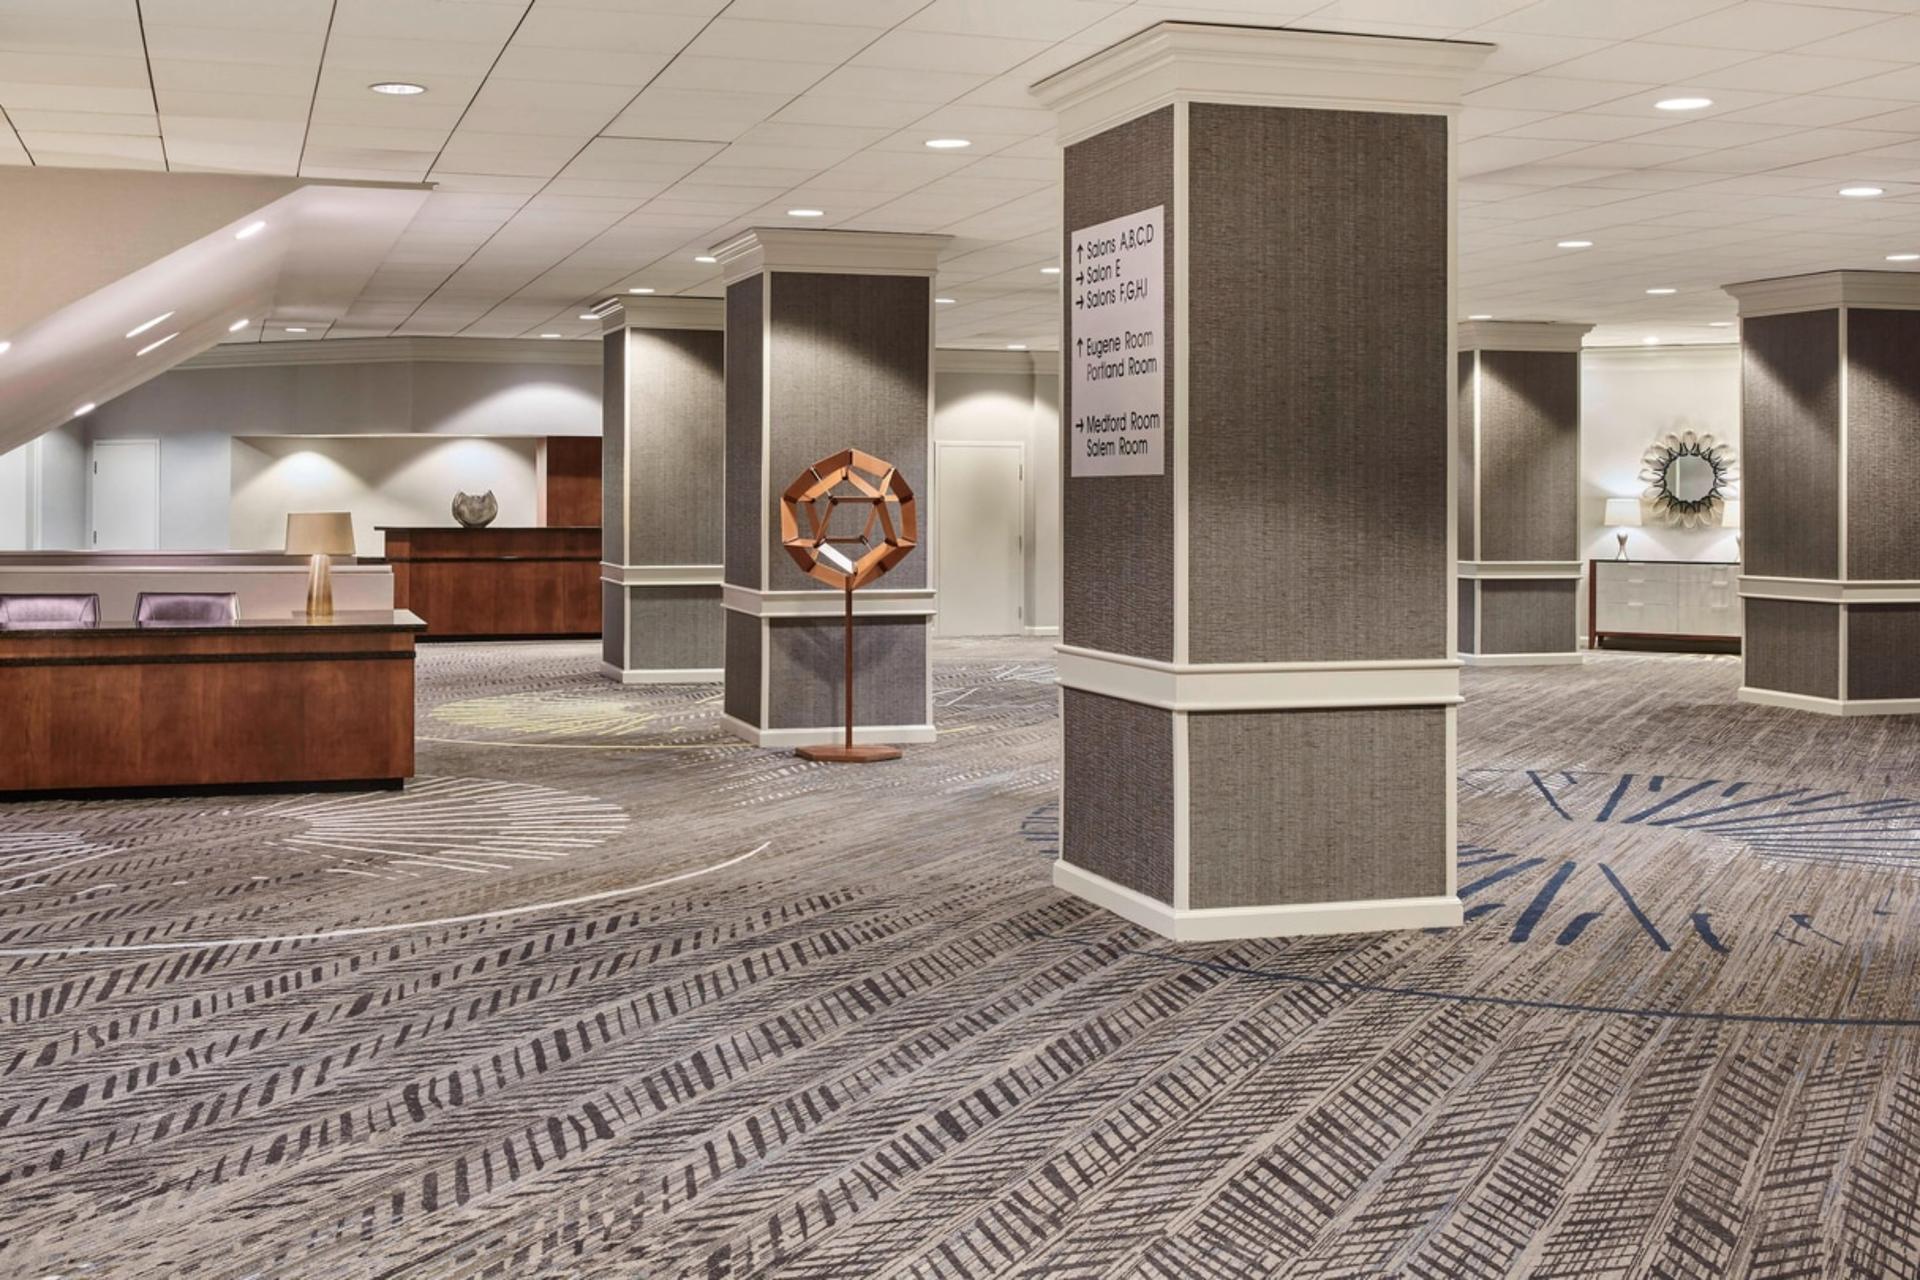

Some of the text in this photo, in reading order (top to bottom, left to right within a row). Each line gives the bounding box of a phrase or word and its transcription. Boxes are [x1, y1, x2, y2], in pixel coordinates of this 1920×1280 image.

[1087, 239, 1116, 260] Salons
[1087, 258, 1121, 284] Salon E
[1087, 289, 1116, 309] Salons
[1087, 330, 1154, 358] Eugene Room
[1087, 357, 1157, 381] Portland Room
[1087, 411, 1160, 434] Medford Room
[1087, 436, 1148, 457] Salem Room
